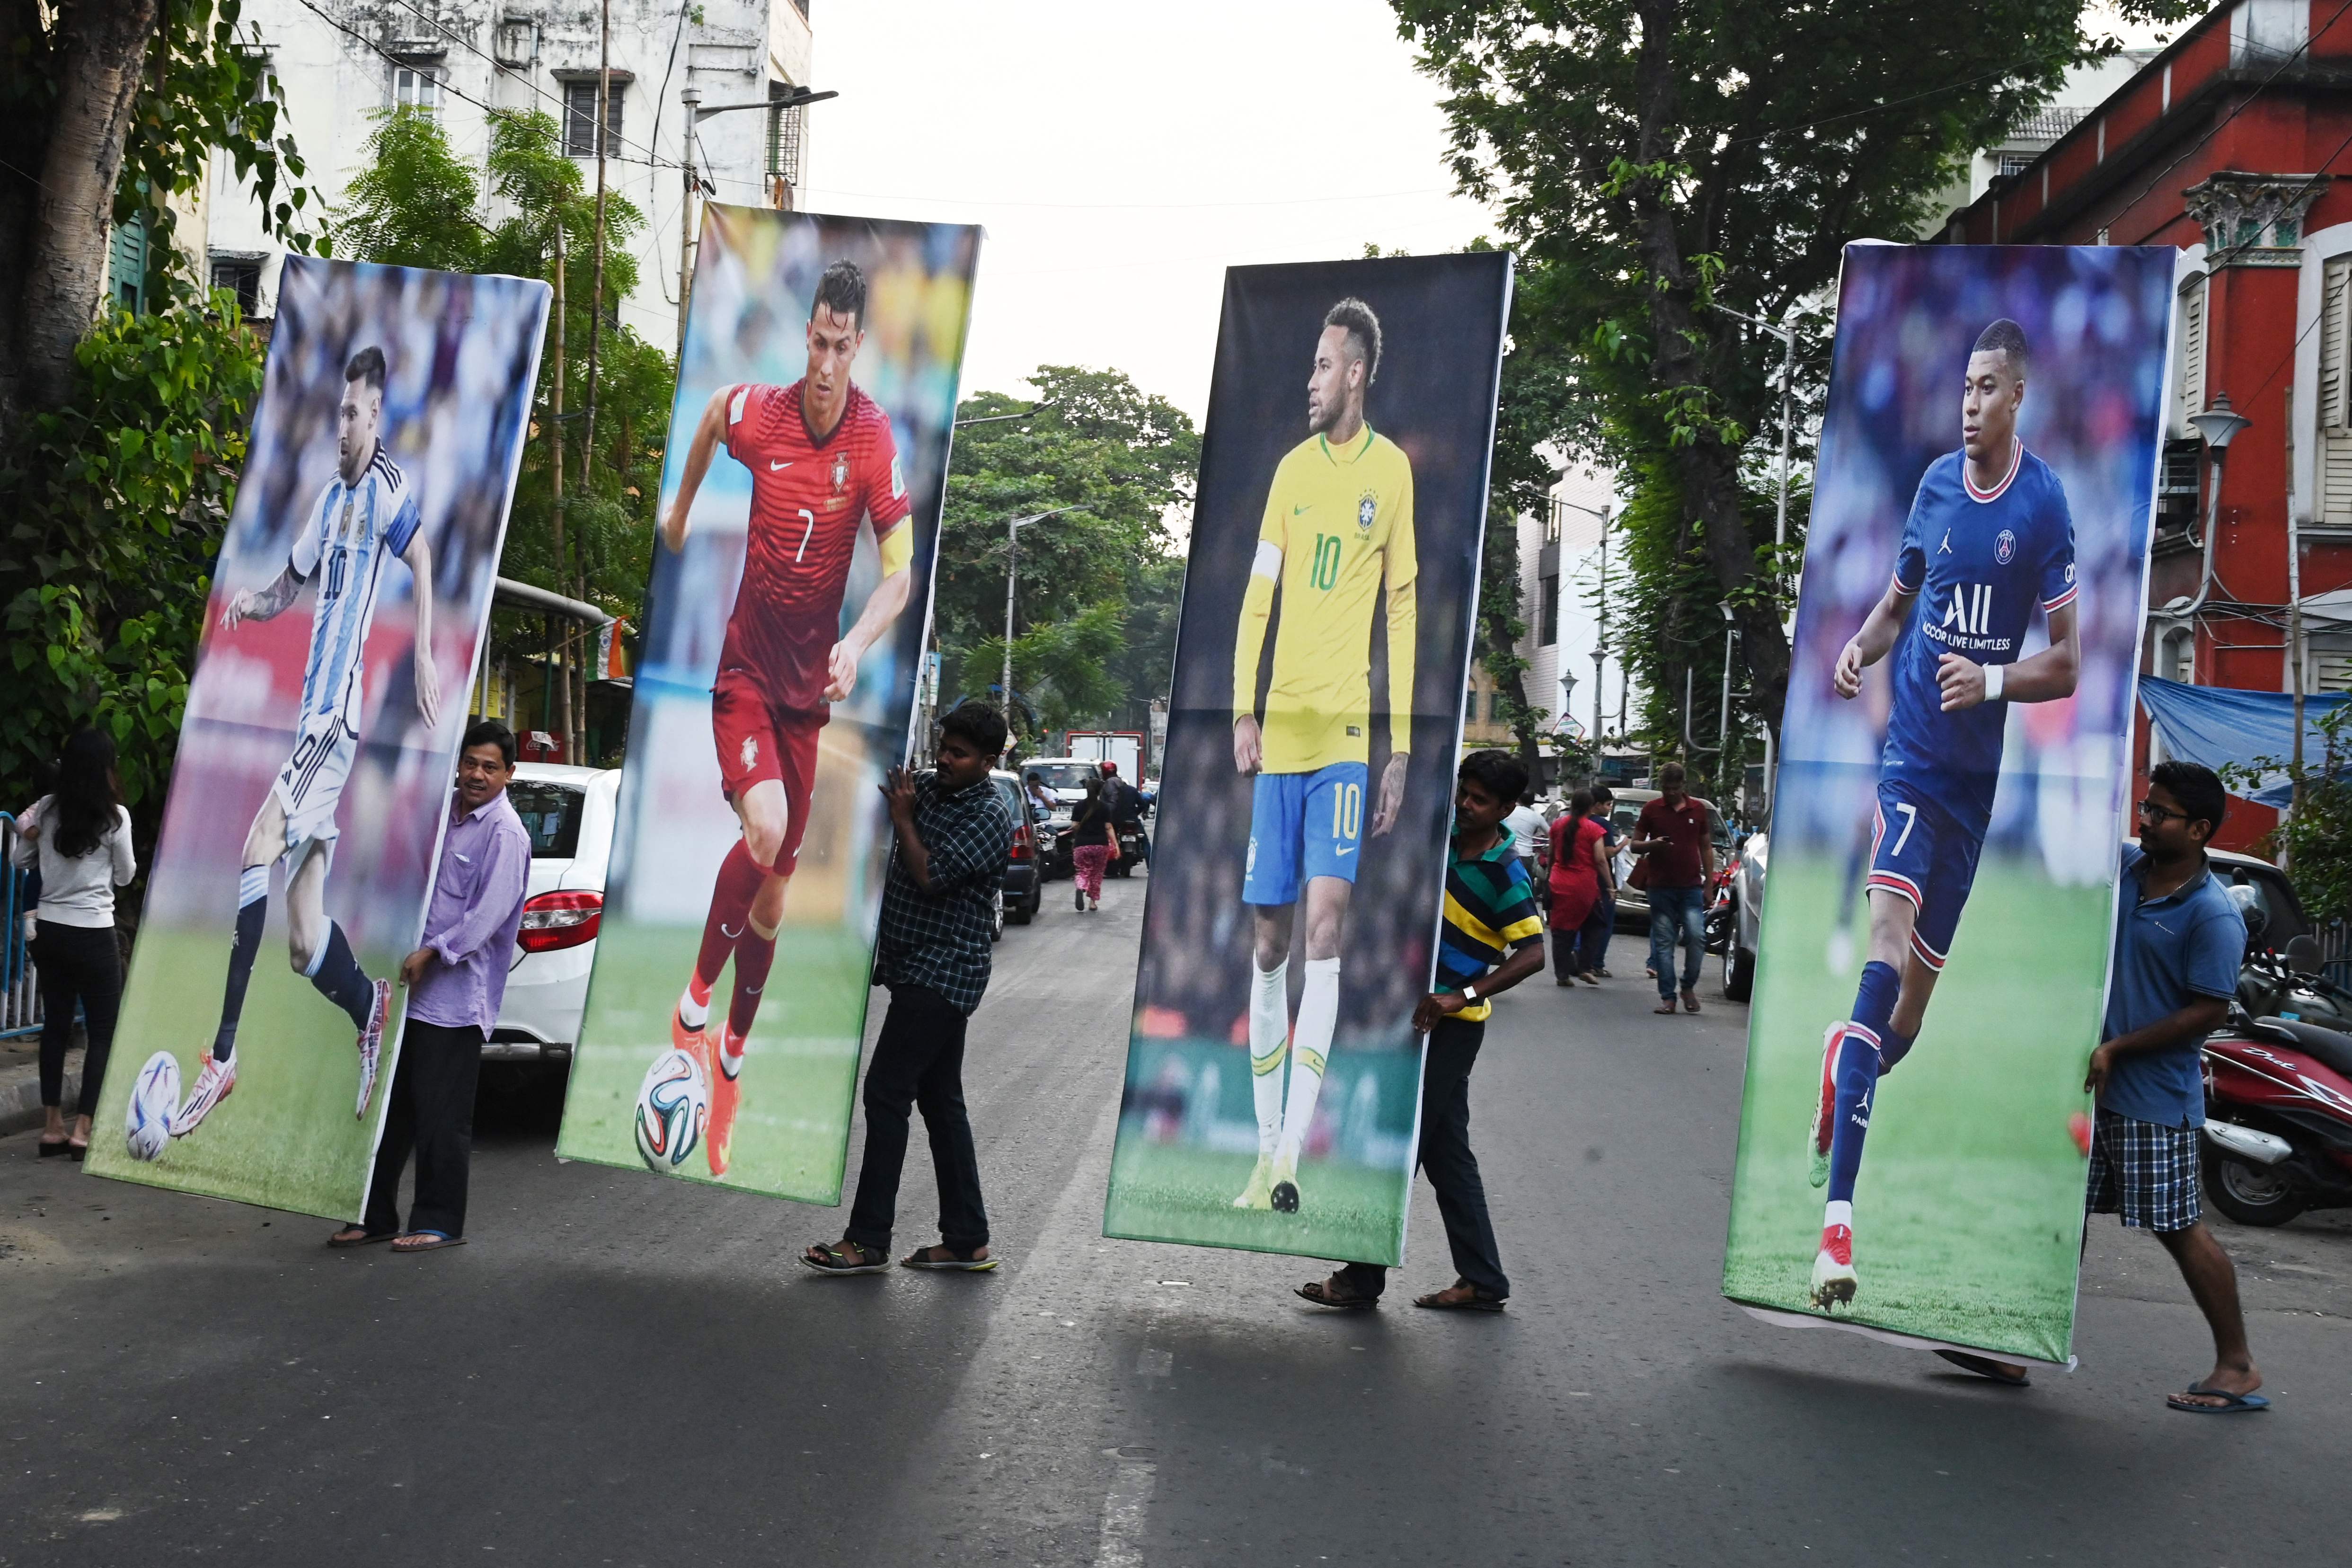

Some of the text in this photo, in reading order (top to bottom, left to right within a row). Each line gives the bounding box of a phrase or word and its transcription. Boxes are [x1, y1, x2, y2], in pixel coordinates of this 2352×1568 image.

[796, 509, 813, 562] 7
[1310, 533, 1341, 590] 10
[324, 549, 347, 600] 10
[1922, 620, 2011, 651] ACCOR LIVE LIMITLESS
[1333, 783, 1360, 840] 10
[1891, 802, 1917, 856] 7
[1851, 1114, 1868, 1128] PARI
